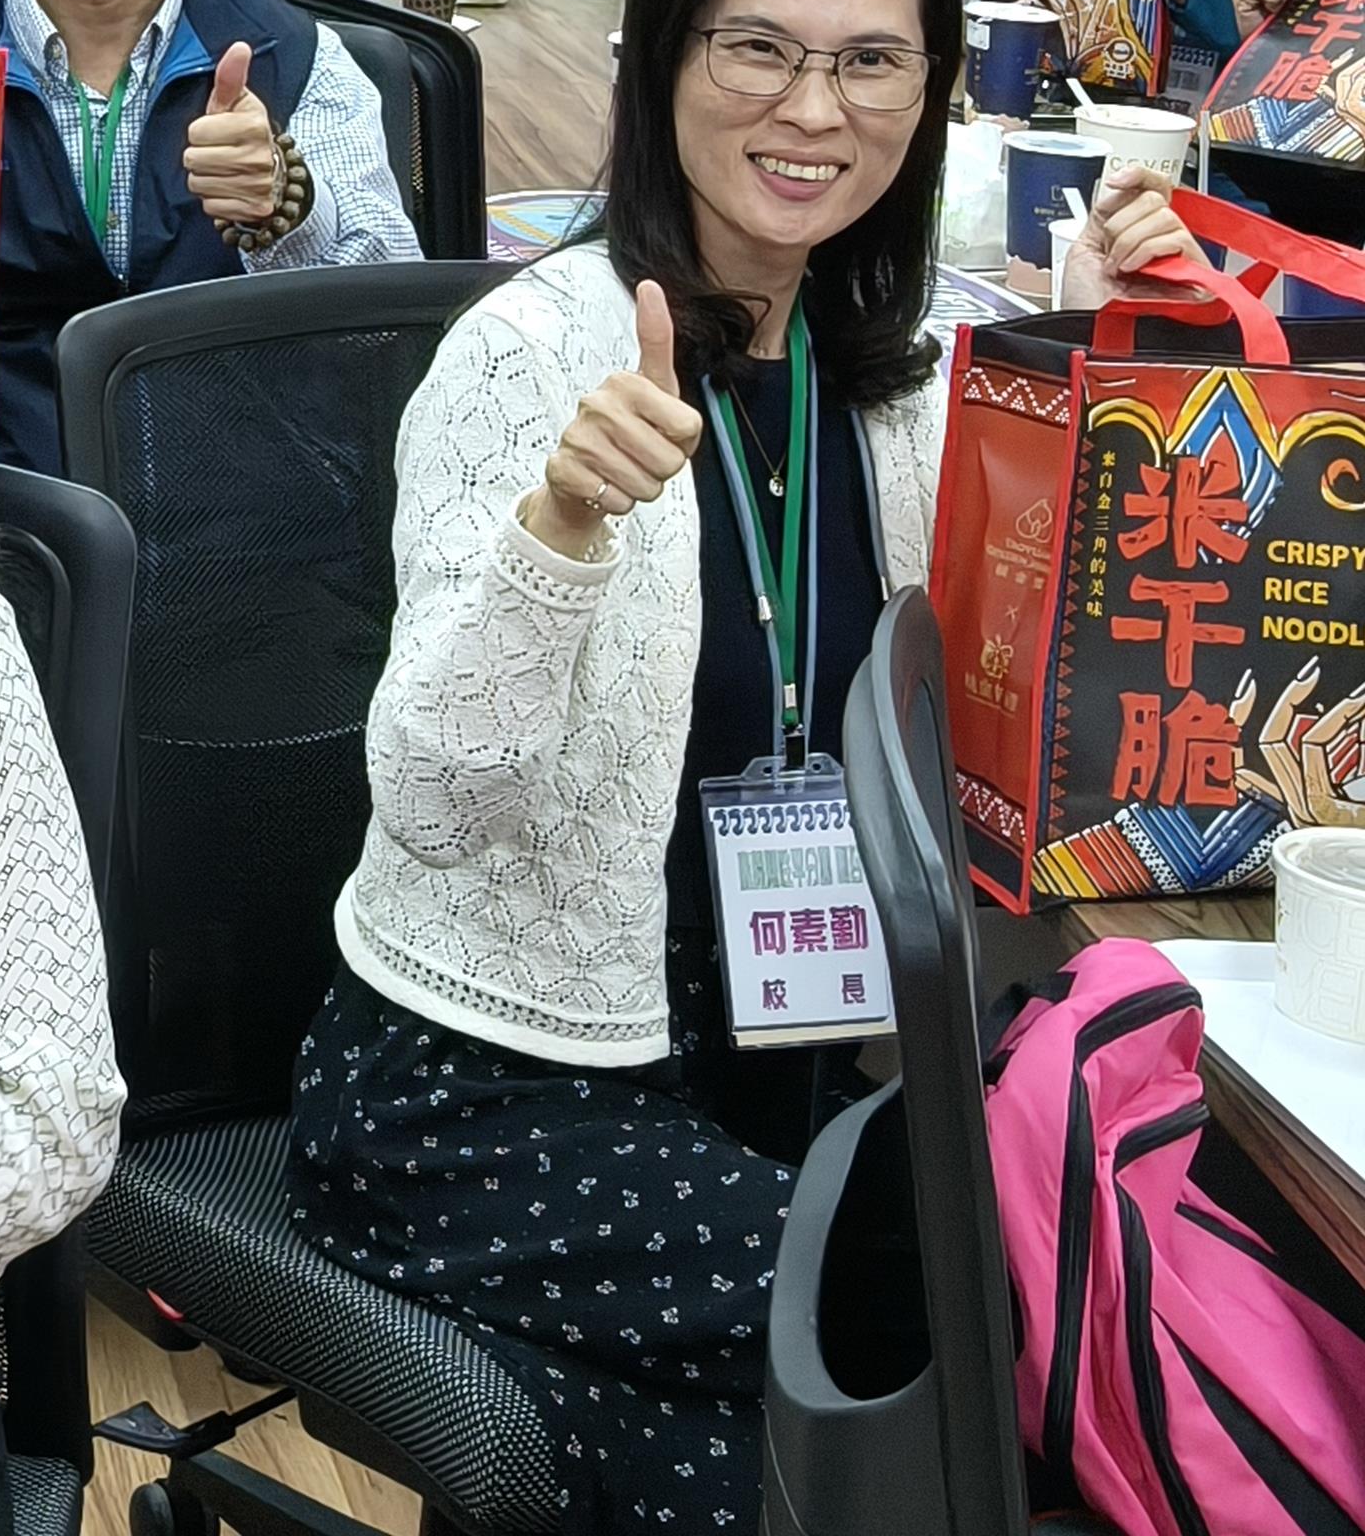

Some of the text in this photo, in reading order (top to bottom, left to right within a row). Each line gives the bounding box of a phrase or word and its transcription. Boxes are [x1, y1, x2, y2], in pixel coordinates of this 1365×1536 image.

[1110, 432, 1250, 806] 米干脆
[1264, 577, 1329, 605] RICE
